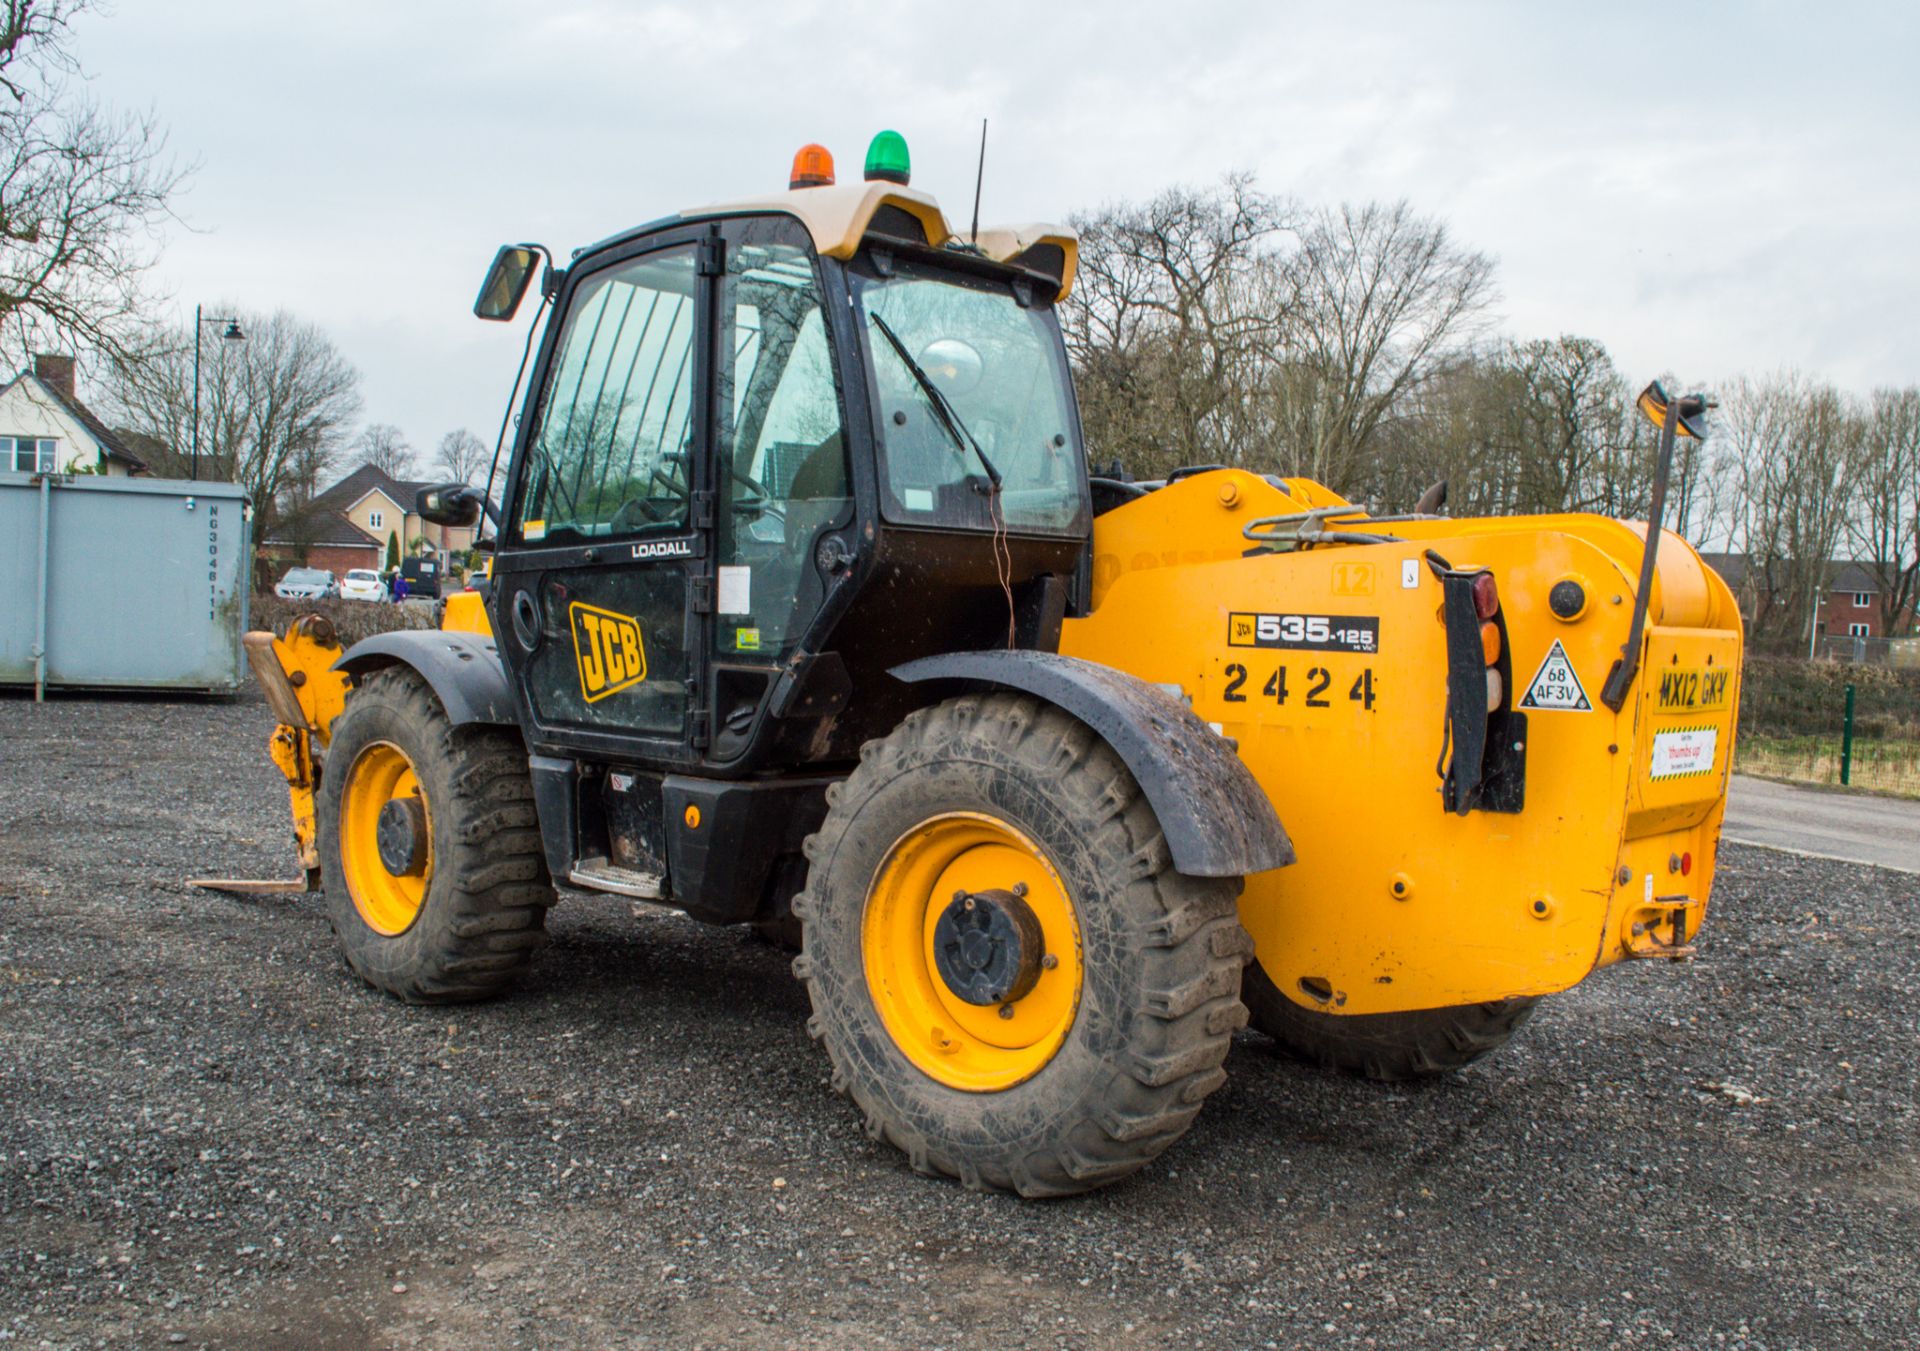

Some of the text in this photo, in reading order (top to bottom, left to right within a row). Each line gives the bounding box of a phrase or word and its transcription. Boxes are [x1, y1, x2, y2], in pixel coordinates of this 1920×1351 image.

[632, 541, 691, 558] LOADALL
[1337, 565, 1370, 593] 12
[582, 613, 641, 692] JCB
[1548, 668, 1566, 682] 68
[1537, 685, 1575, 701] AF3V
[1659, 671, 1728, 707] MX12 GKY
